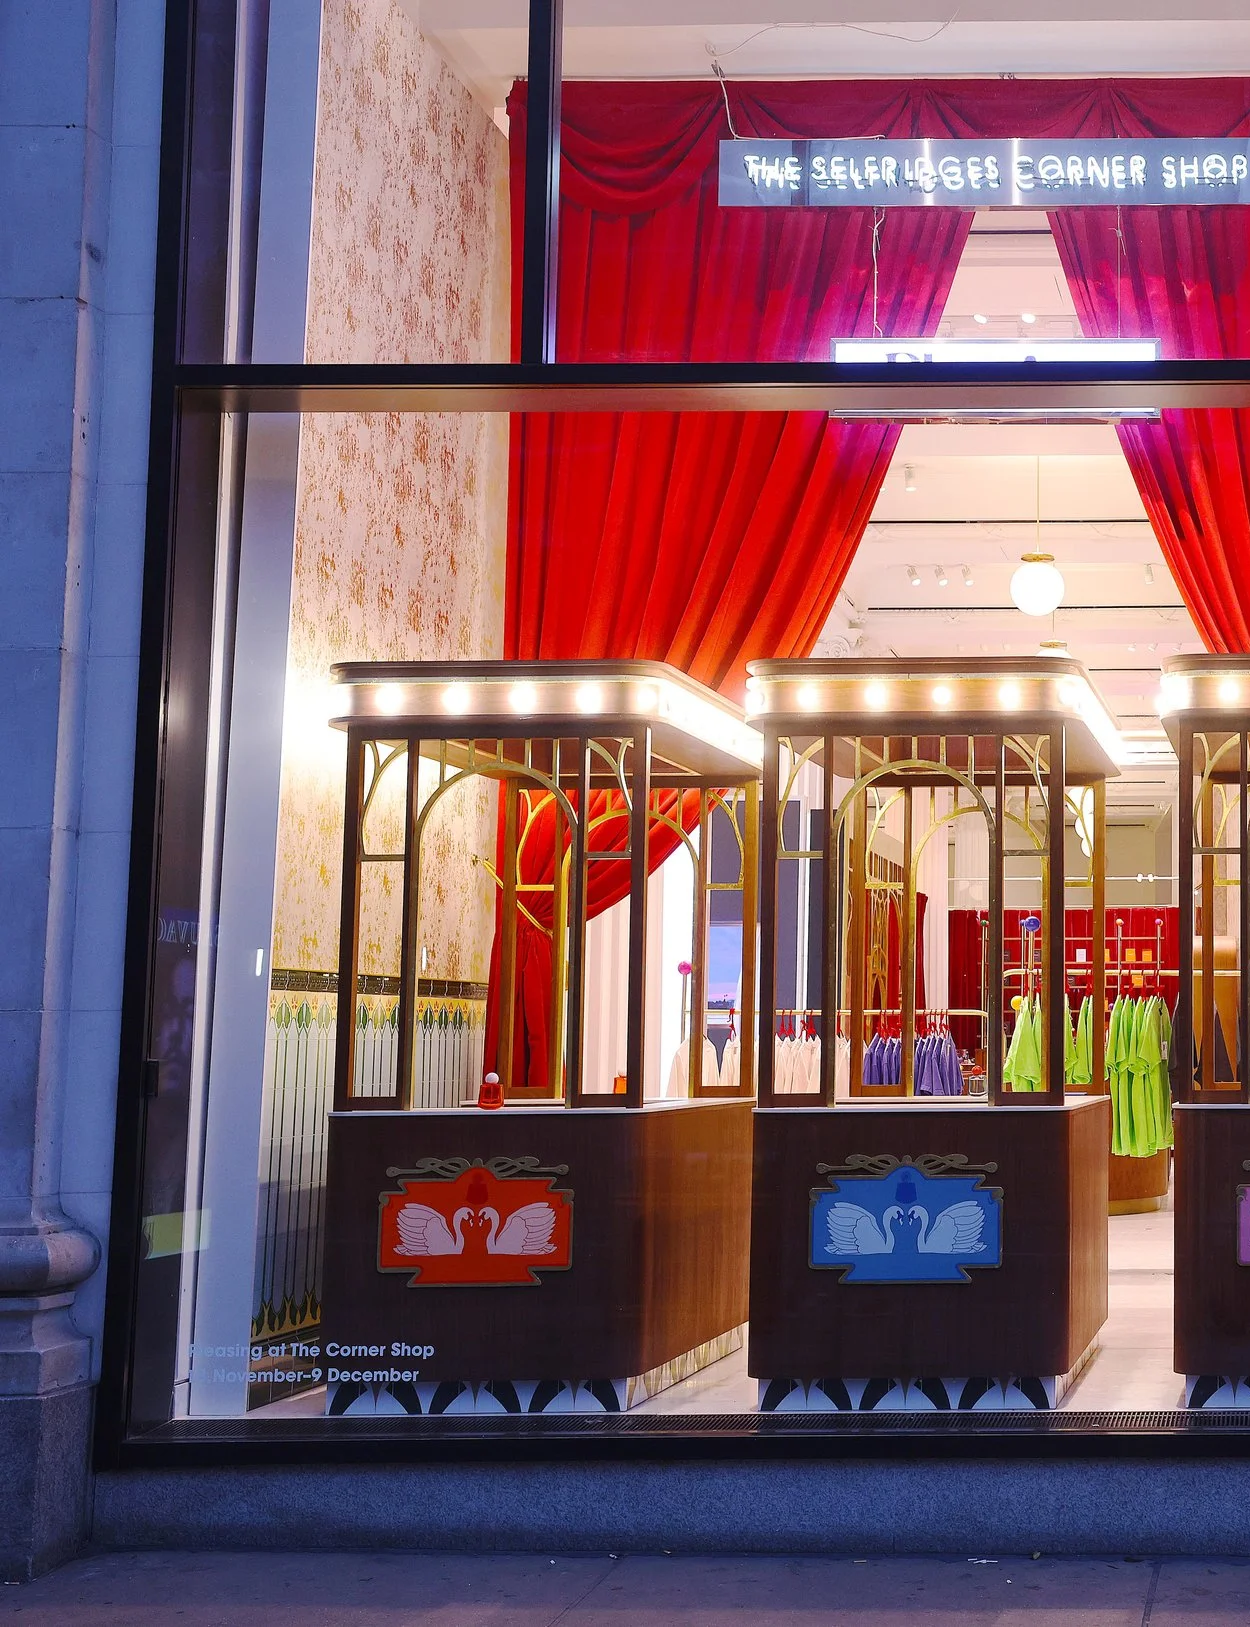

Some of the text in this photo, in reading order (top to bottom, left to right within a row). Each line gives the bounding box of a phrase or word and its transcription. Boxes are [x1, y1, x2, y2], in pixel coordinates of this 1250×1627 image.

[743, 154, 1248, 191] THE SELFRIDGES CORNER SHOP
[189, 1342, 435, 1360] Peasing at The Corner Shop
[327, 1367, 420, 1383] December
